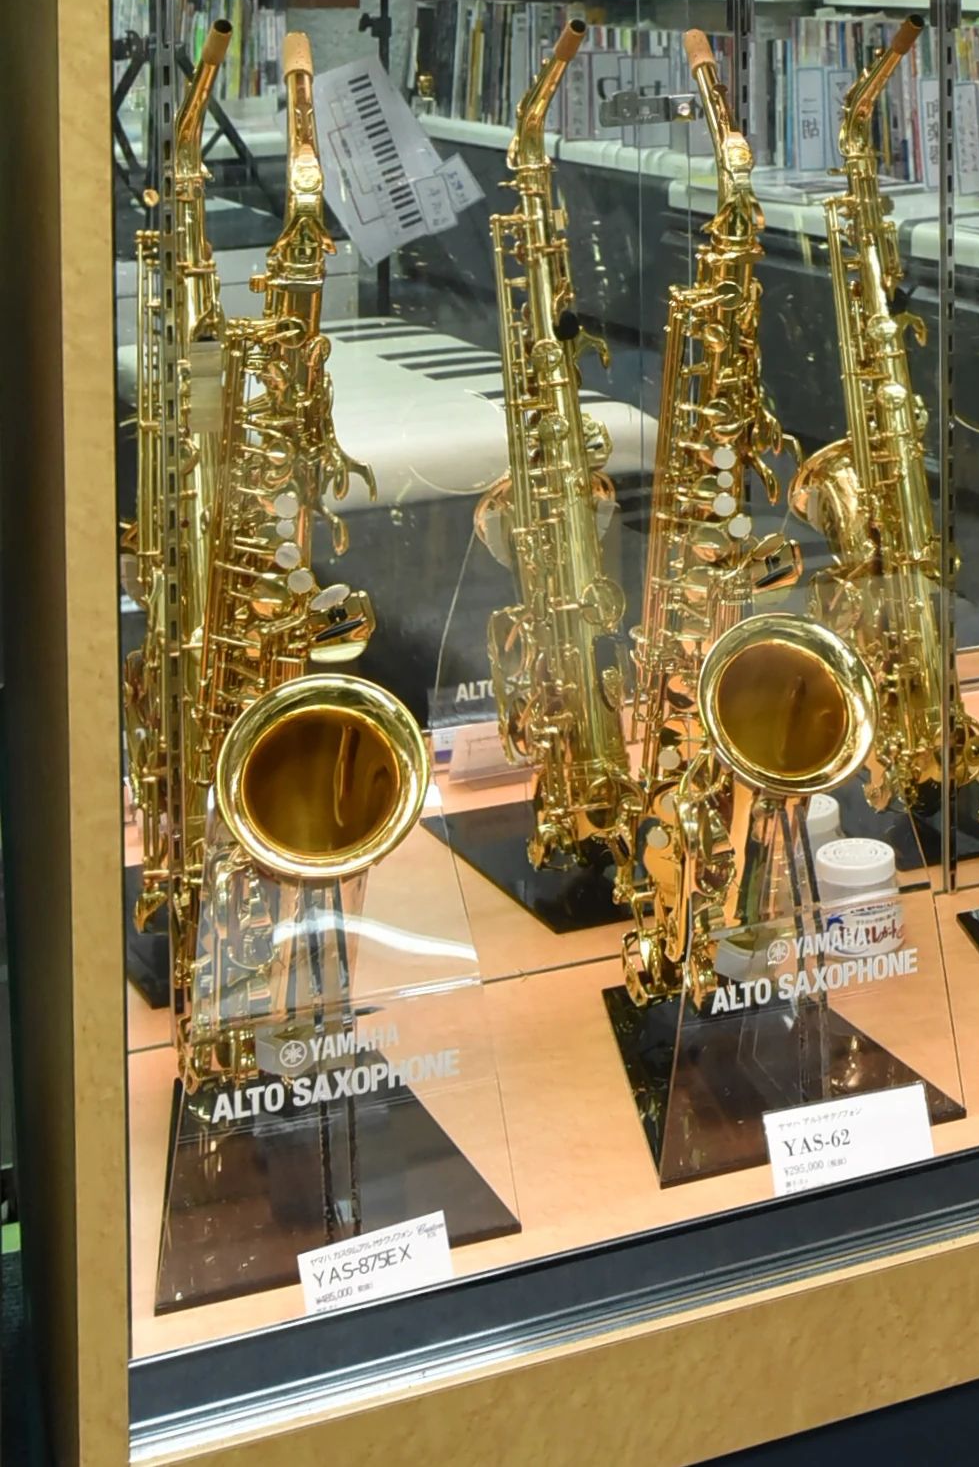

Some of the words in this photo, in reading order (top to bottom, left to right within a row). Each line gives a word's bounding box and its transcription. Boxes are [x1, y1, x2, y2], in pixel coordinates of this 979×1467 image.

[791, 928, 869, 960] YAMAHA
[710, 978, 772, 1015] ALTO
[778, 948, 918, 1000] SAXOPHONE
[309, 1023, 399, 1062] YAMAHA
[211, 1083, 286, 1124] ALTO
[292, 1049, 461, 1107] SAXOPHONE
[778, 1120, 802, 1132] ヤマハ
[802, 1107, 863, 1126] アルトサクソフォン
[781, 1128, 851, 1158] YAS-62
[783, 1159, 825, 1178] ¥295,000
[310, 1254, 332, 1267] ヤマハ
[312, 1243, 413, 1289] YAS-875EX
